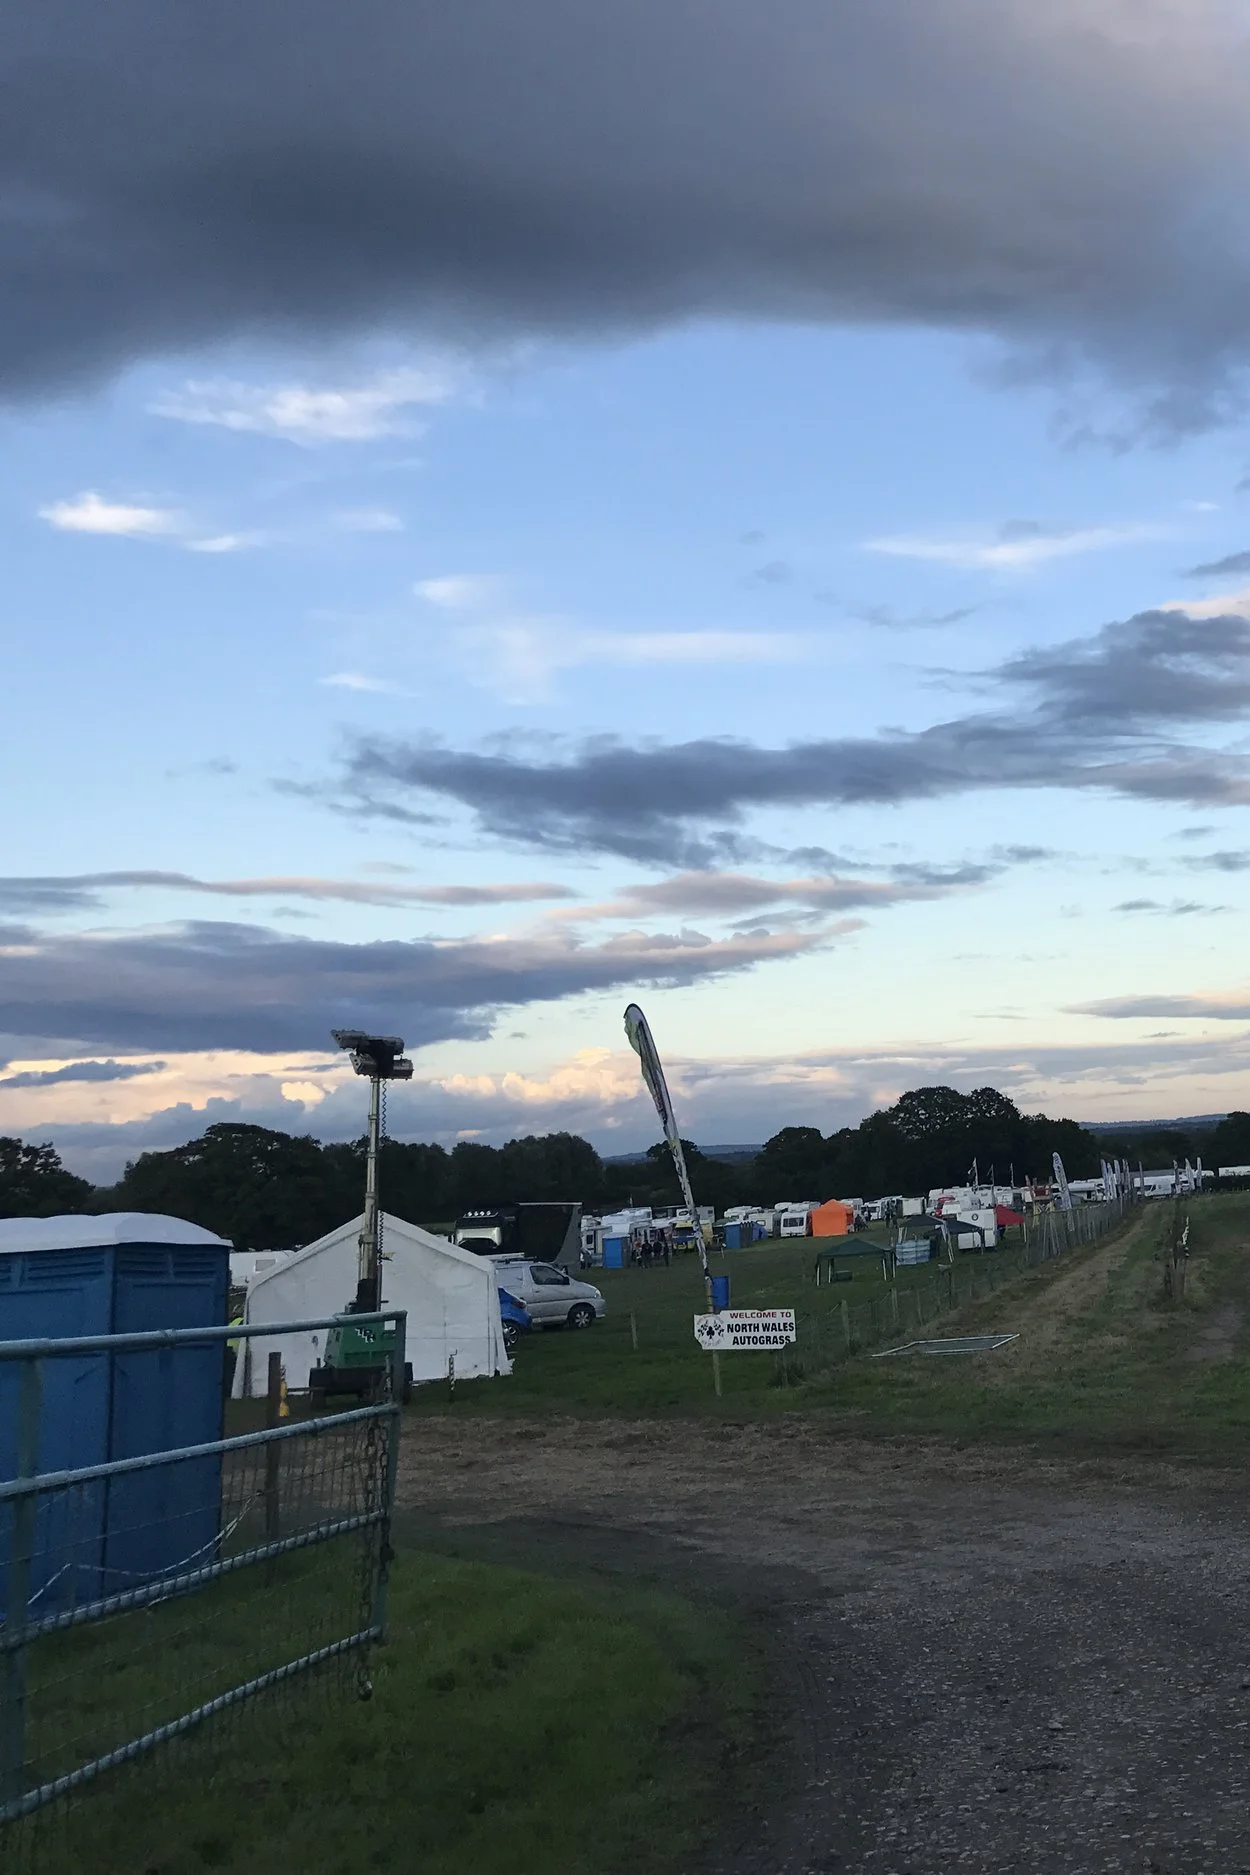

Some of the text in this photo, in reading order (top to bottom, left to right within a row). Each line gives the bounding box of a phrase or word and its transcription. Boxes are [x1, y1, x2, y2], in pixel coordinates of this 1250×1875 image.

[729, 1311, 777, 1319] WELCOME
[726, 1322, 795, 1333] NORTH WALES
[732, 1335, 791, 1345] AUTOGRASS
